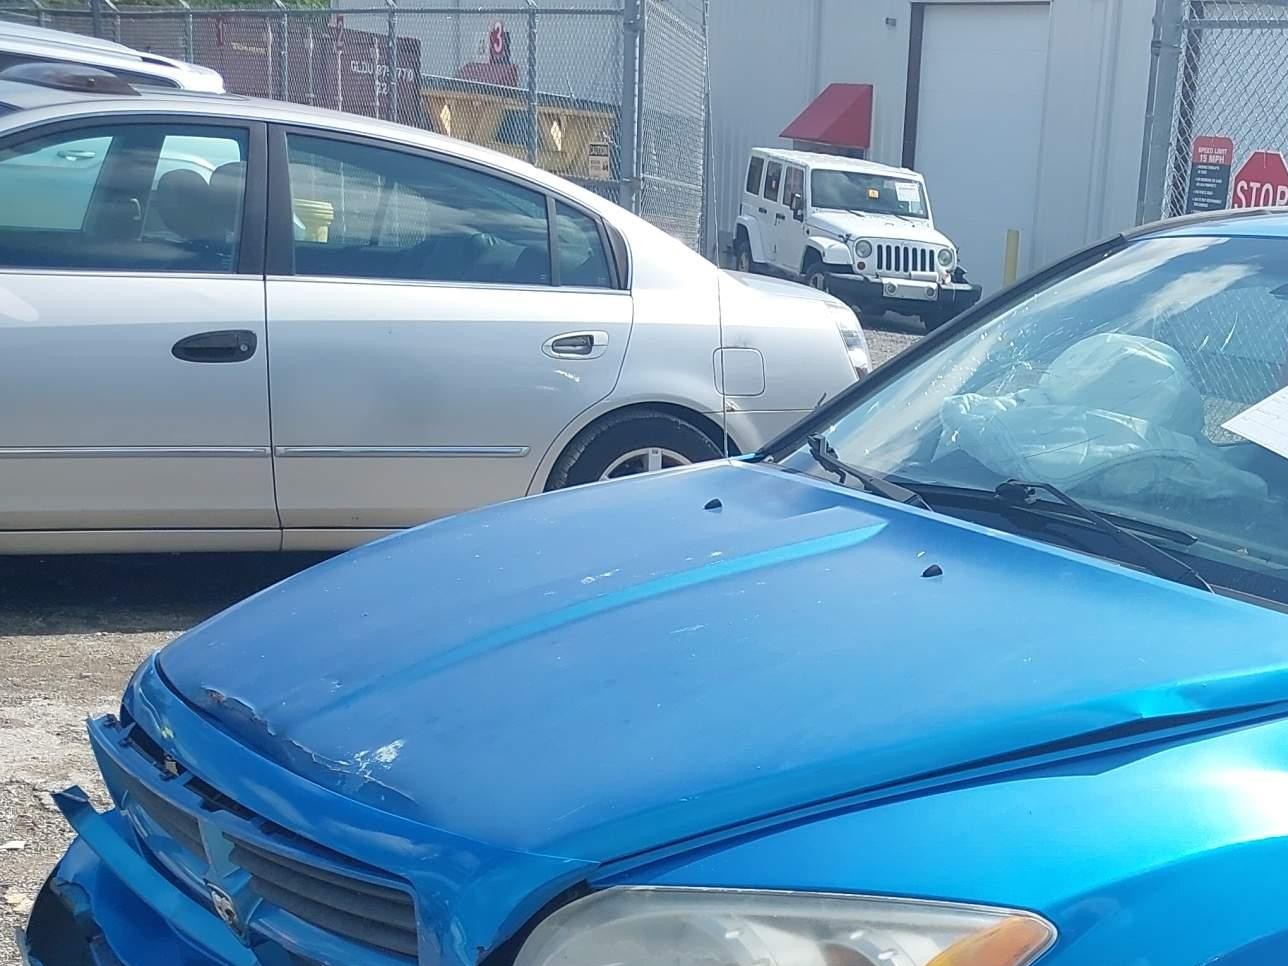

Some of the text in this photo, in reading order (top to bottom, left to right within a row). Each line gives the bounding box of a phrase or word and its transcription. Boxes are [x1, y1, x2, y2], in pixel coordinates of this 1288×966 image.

[493, 21, 503, 54] 3
[1199, 154, 1225, 164] 15 MPH
